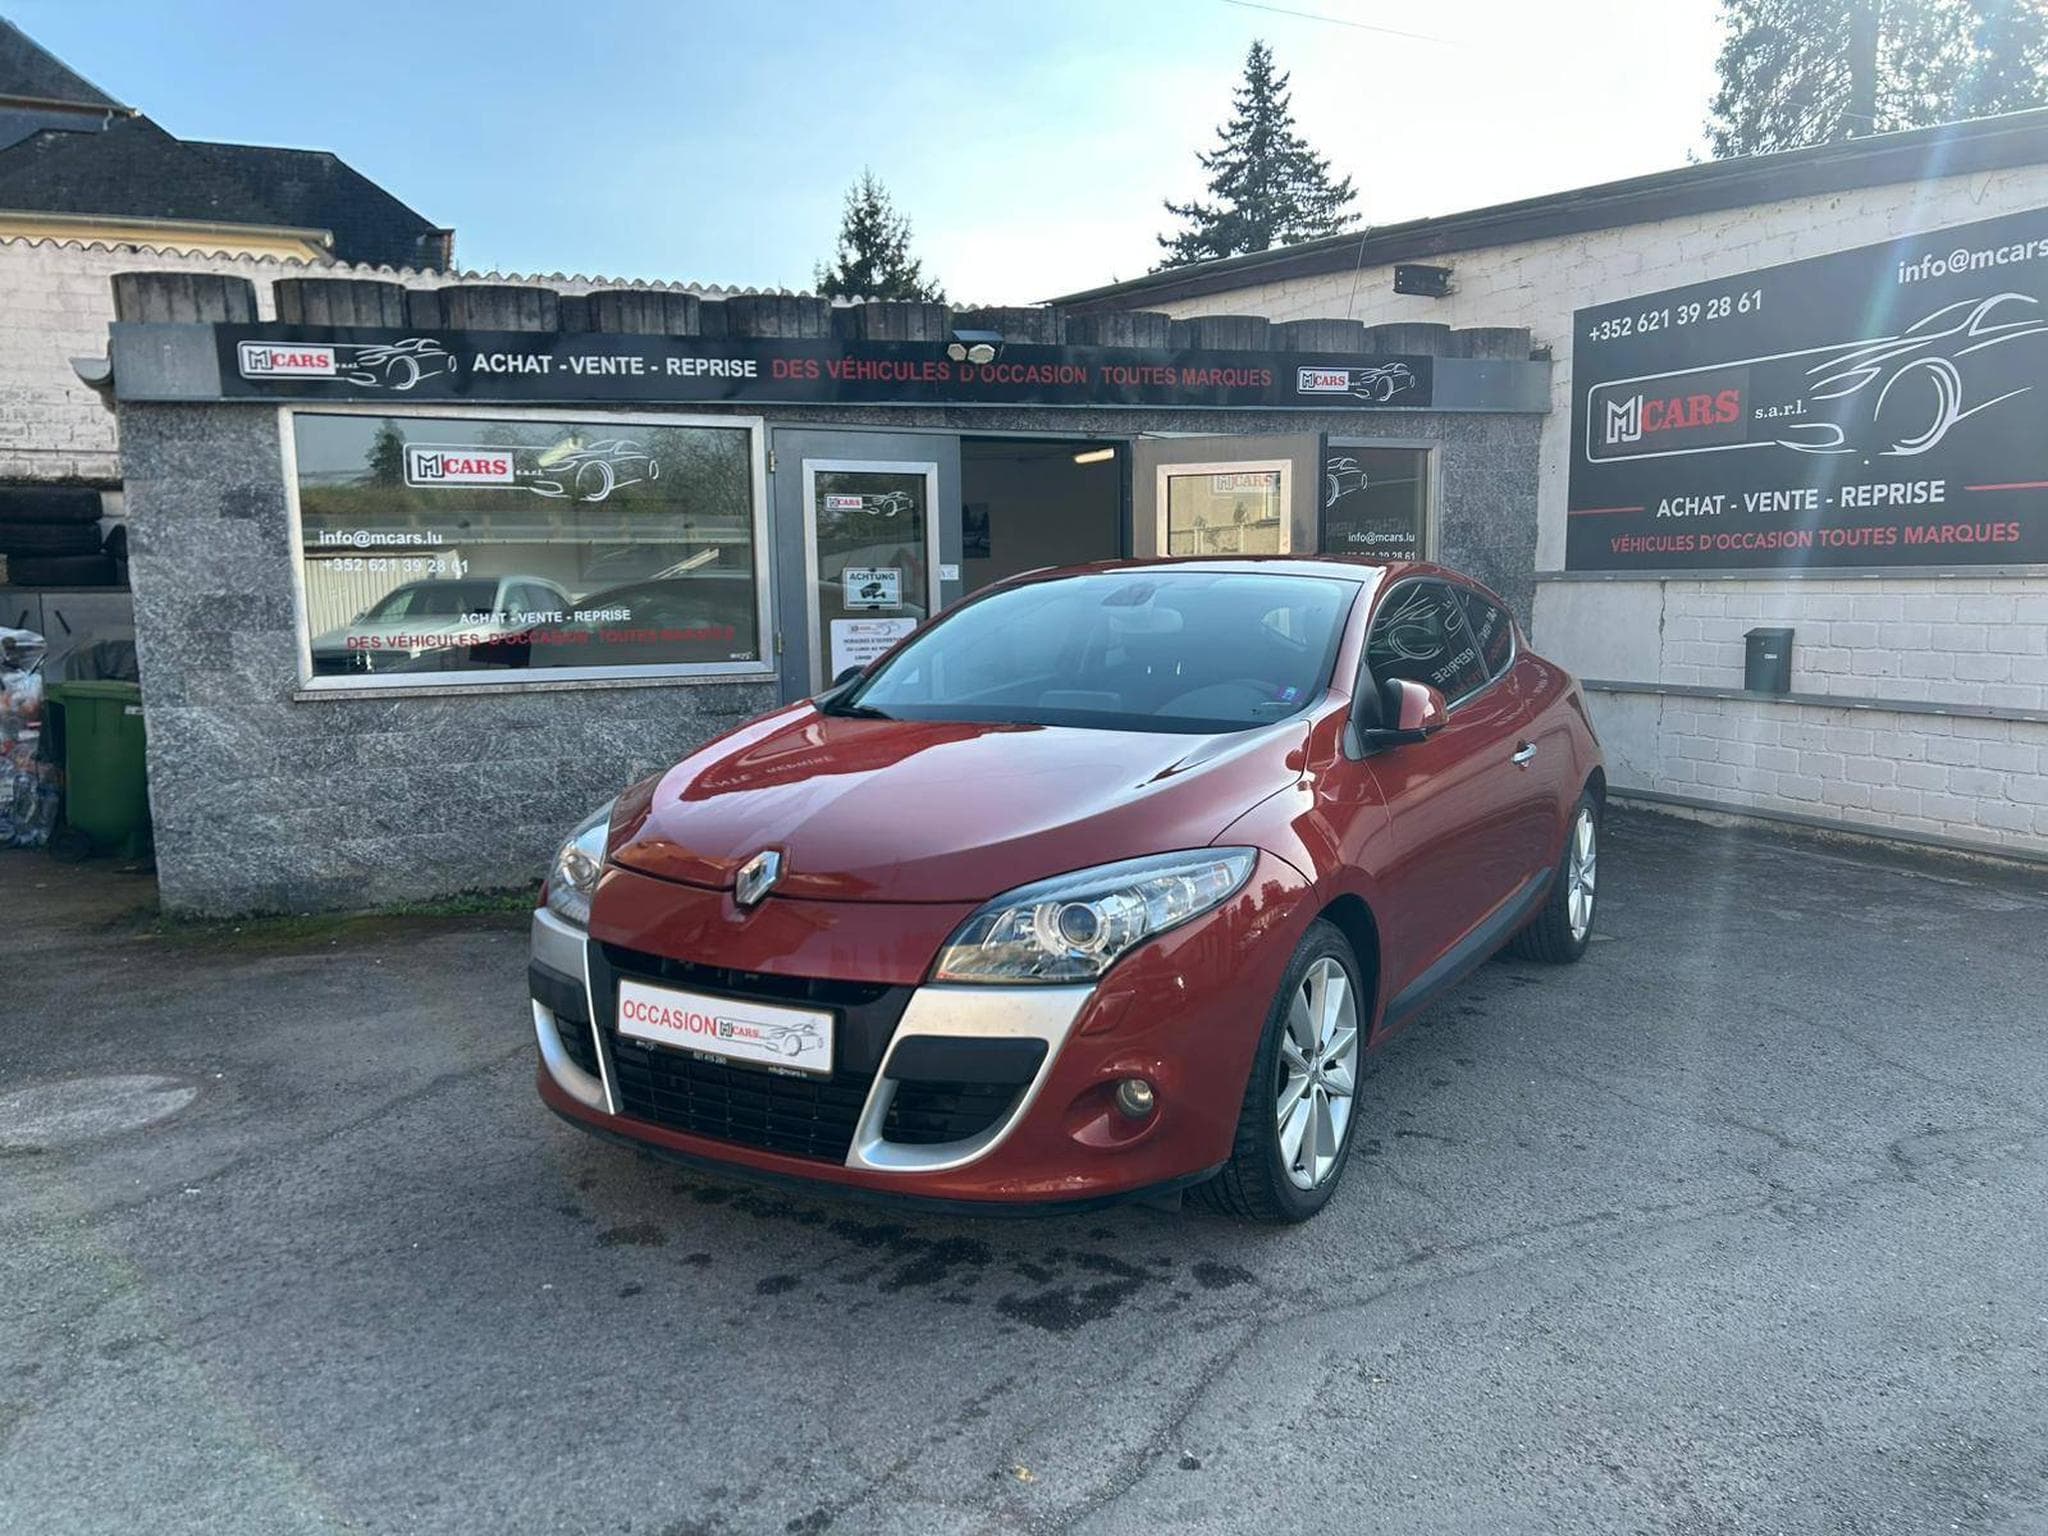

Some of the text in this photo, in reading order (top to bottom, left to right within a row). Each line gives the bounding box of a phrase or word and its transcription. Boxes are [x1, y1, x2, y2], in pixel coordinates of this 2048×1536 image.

[1588, 288, 1762, 341] +352 621 39 28 61
[472, 353, 553, 374] ACHAT
[666, 357, 757, 377] REPRISE
[772, 358, 820, 380] DES
[826, 356, 950, 381] VÉHICULES
[1102, 365, 1177, 385] TOUTES
[1182, 367, 1273, 387] MARQUES
[1754, 399, 1808, 419] s.a.r.l.
[1656, 494, 1726, 518] ACHAT
[1743, 488, 1819, 513] VENTE
[1841, 480, 1945, 507] REPRISE
[319, 530, 443, 548] info@mcars.lu
[1348, 531, 1416, 545] info@mcars.lu
[1611, 521, 2021, 553] VÉHICULES D'OCCASION TOUTES MARQUES
[322, 558, 364, 573] +352
[368, 557, 396, 572] 621
[403, 557, 422, 573] 39
[427, 557, 446, 573] 28
[849, 573, 896, 581] ACHTUNG
[459, 613, 506, 625] ACHAT
[519, 611, 563, 624] VENTE
[574, 609, 631, 621] REPRISE
[347, 636, 381, 649] DES
[386, 632, 480, 648] VÉHICULES
[623, 999, 717, 1037] OCCASION
